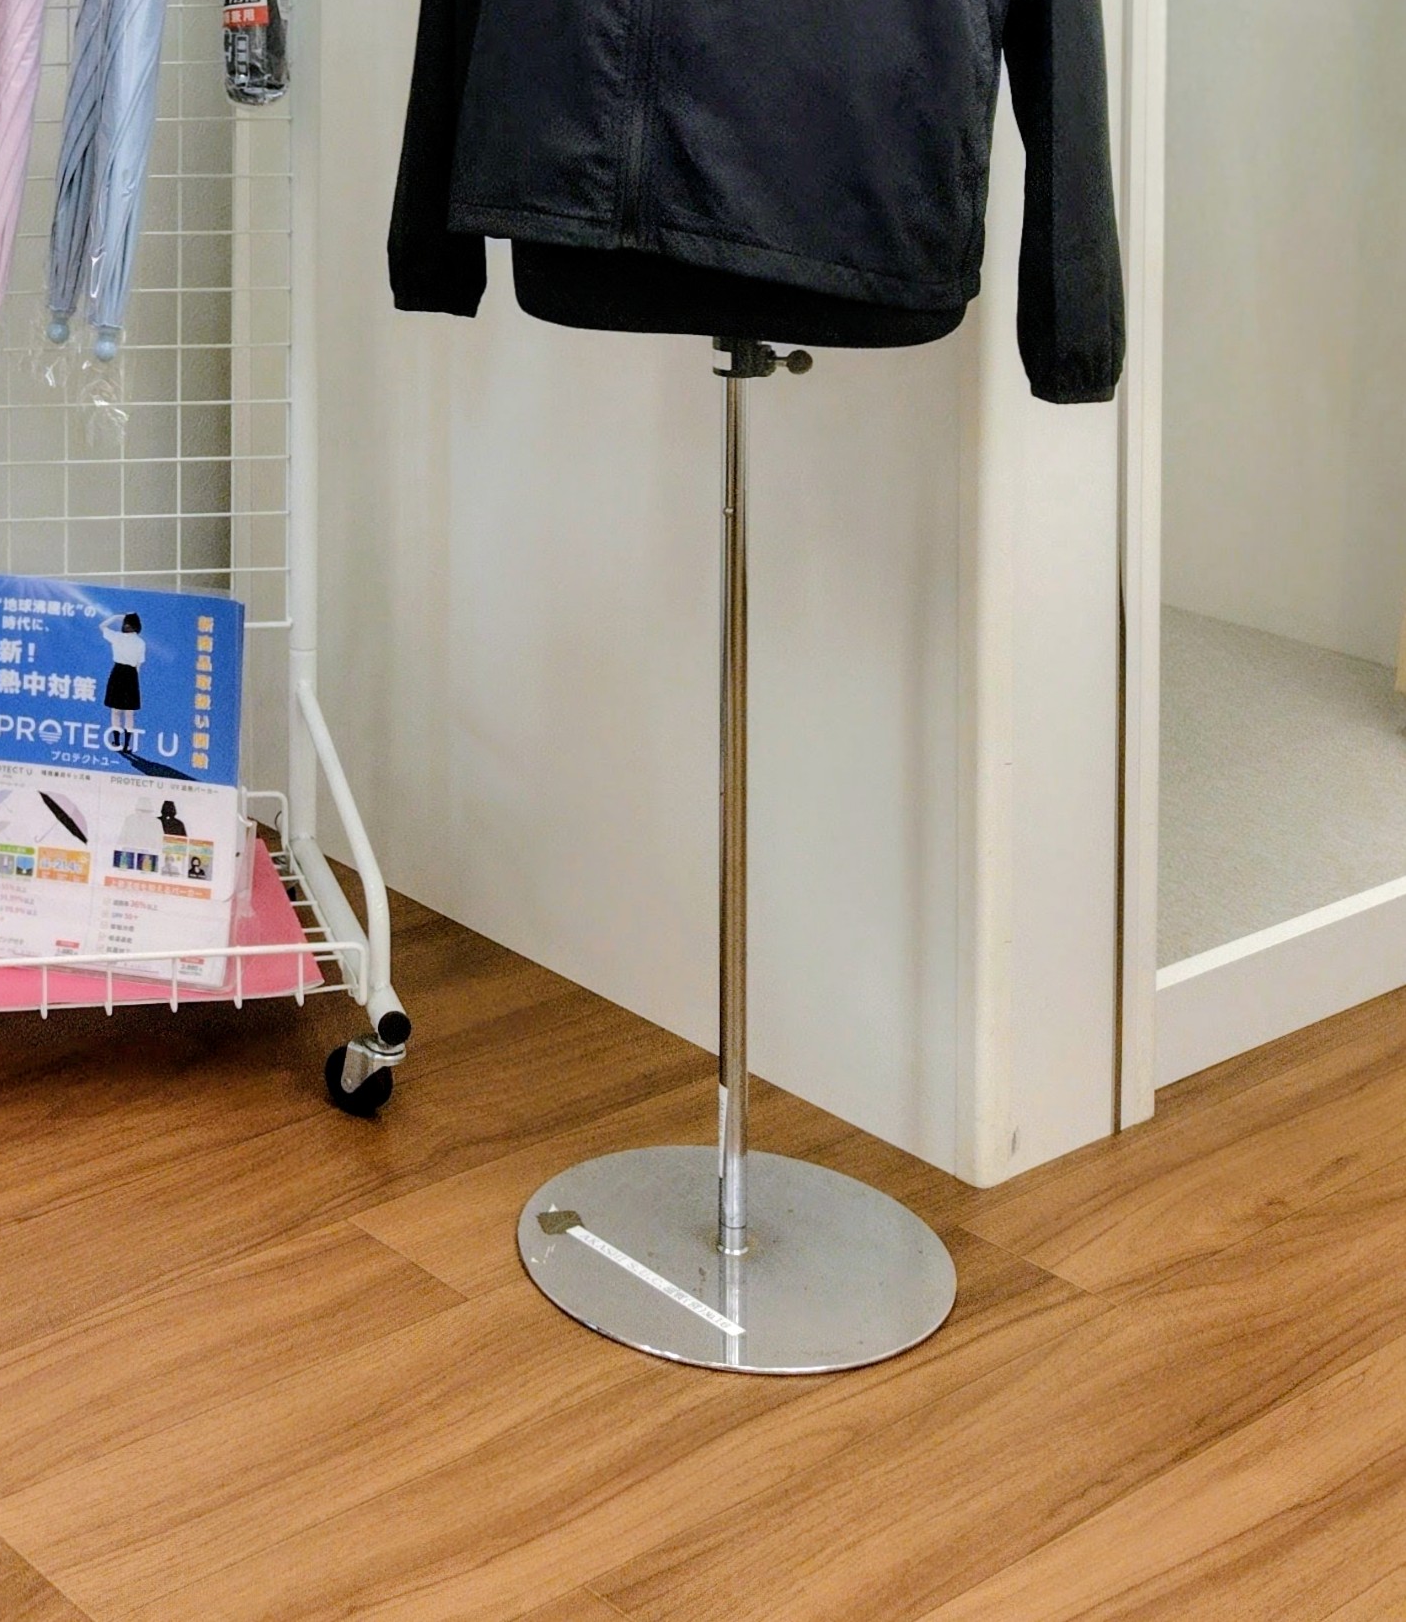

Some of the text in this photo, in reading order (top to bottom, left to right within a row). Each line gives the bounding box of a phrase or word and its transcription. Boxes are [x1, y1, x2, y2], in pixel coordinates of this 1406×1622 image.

[2, 615, 50, 633] 時代に、
[158, 732, 179, 758] U
[51, 750, 120, 767] プロテクトユー
[26, 767, 33, 776] U
[110, 776, 164, 789] PROTECT U
